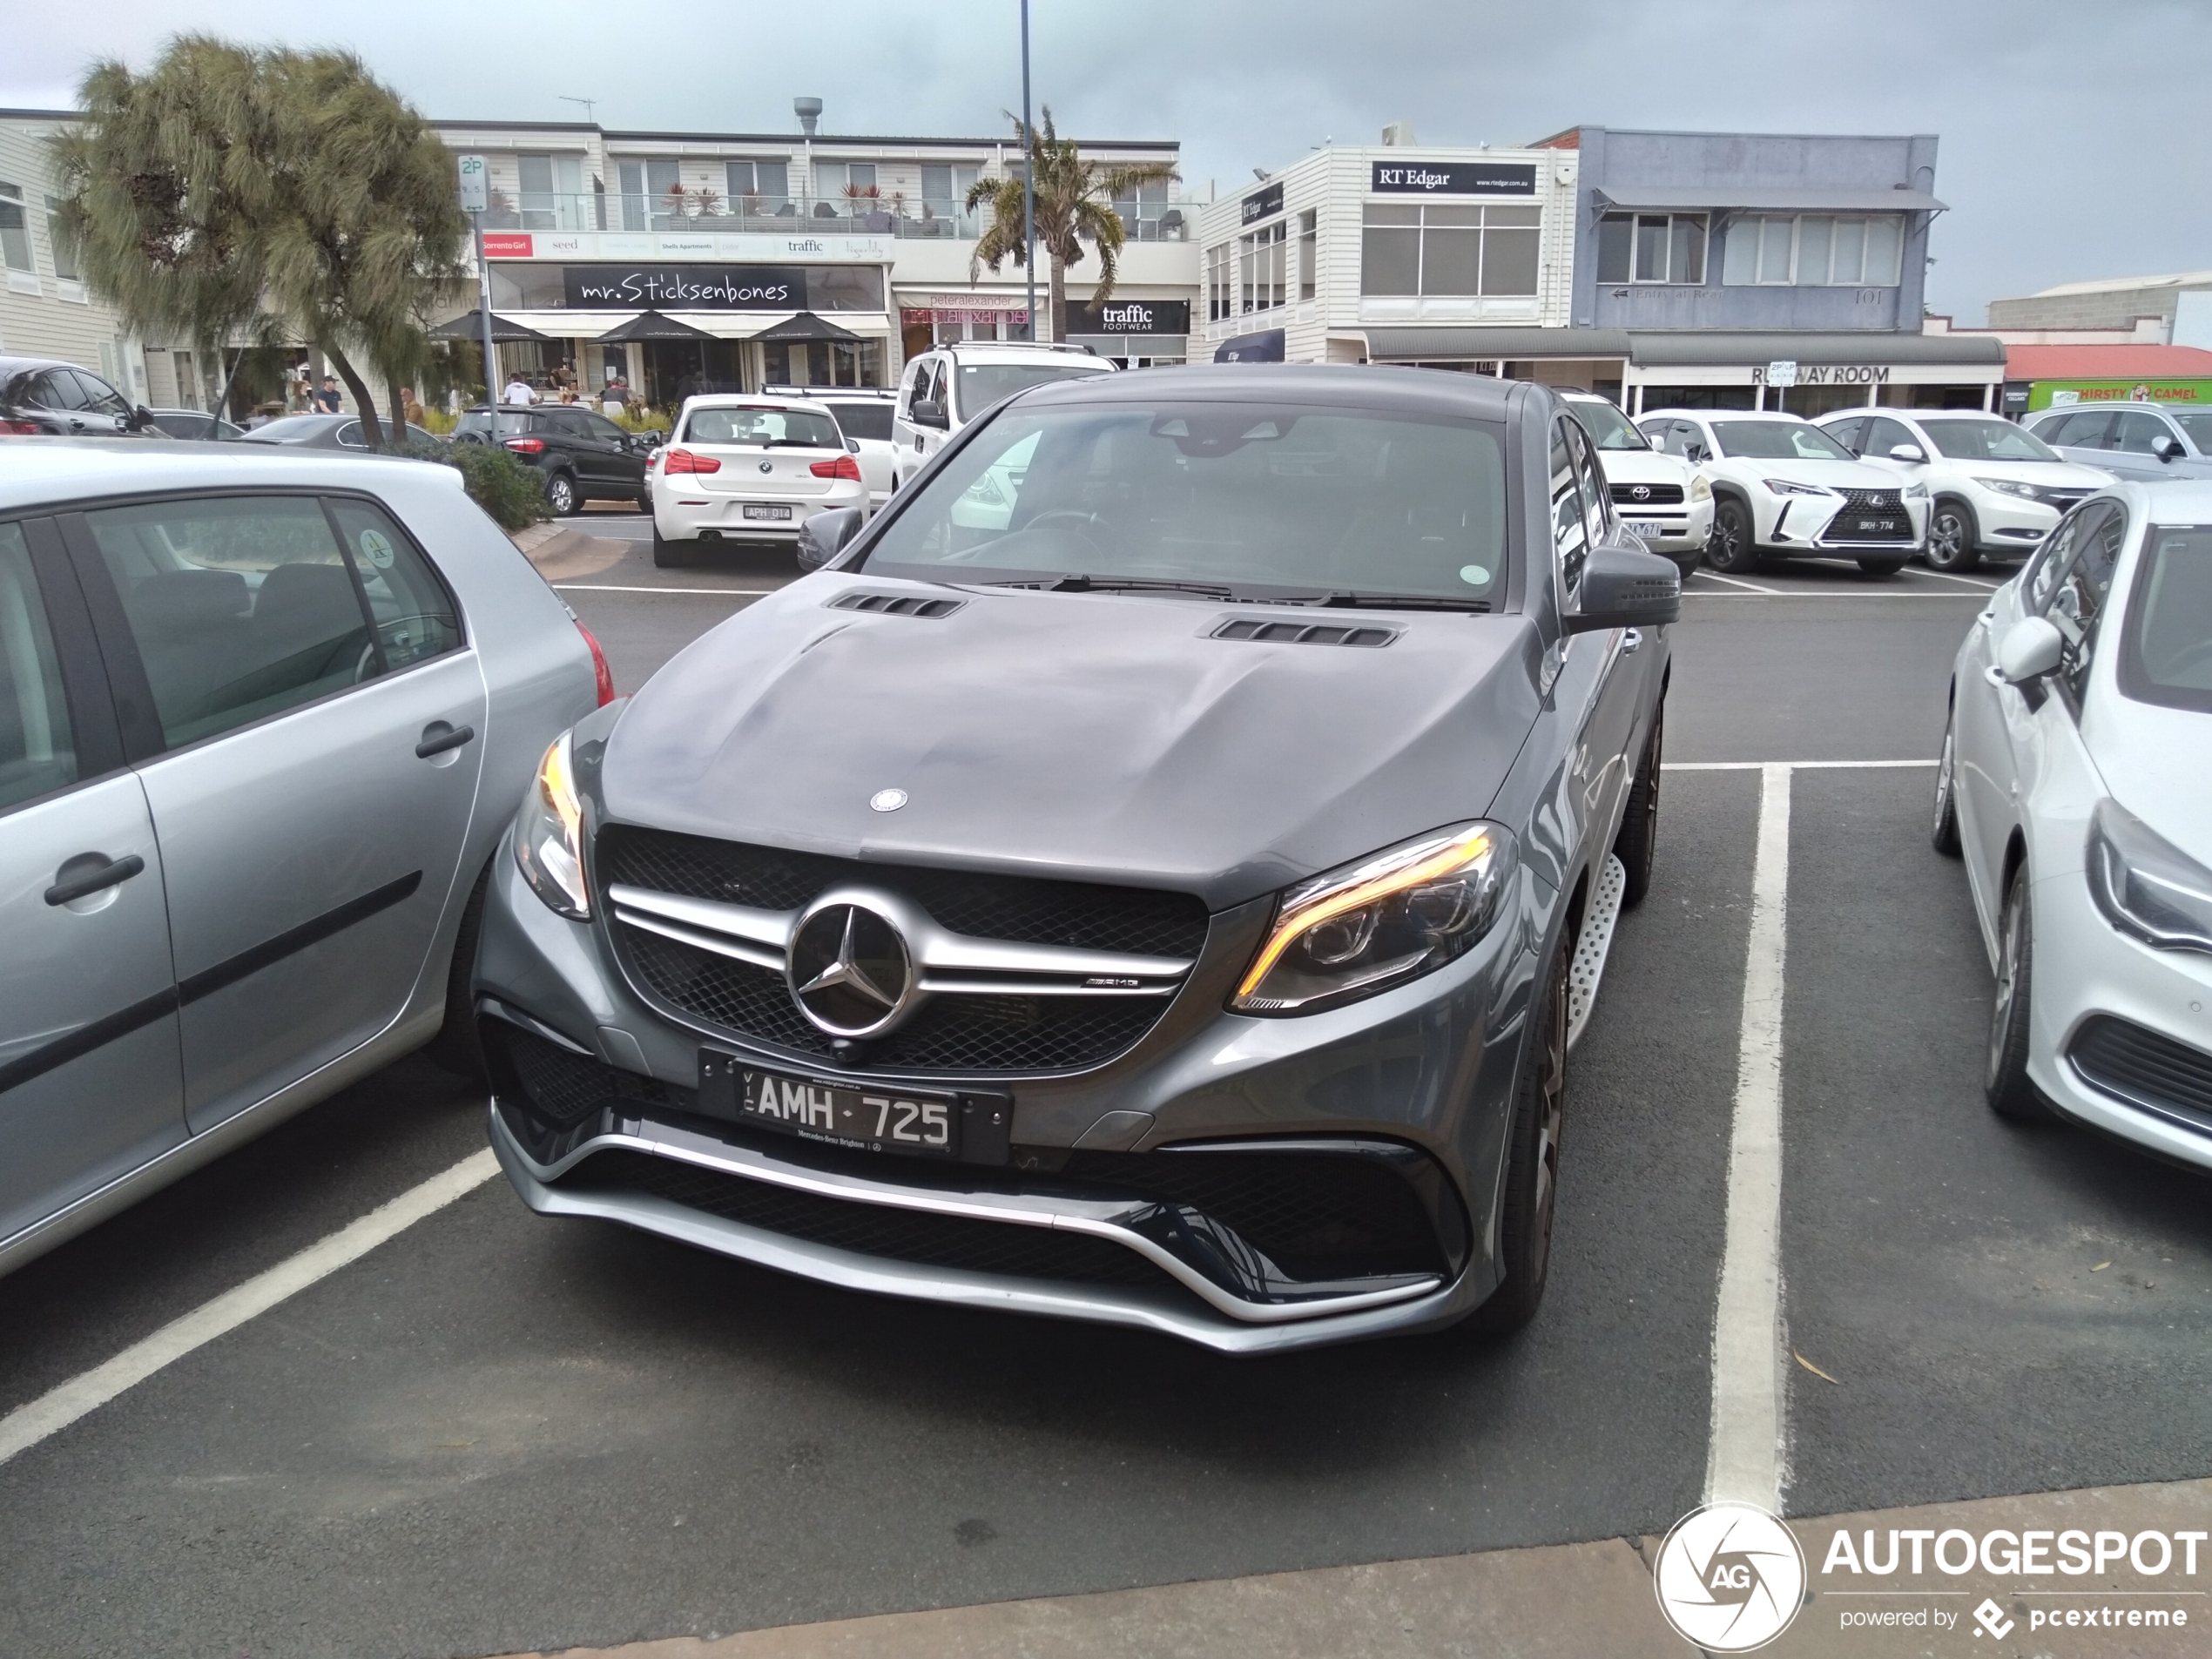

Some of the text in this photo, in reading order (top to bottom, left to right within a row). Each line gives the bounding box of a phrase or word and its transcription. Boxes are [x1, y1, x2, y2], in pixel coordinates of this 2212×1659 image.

[462, 160, 482, 174] 2P
[1379, 169, 1450, 189] RT Edgar
[552, 239, 578, 250] seed
[788, 239, 823, 252] traffic
[930, 294, 1012, 307] peteralexander
[1635, 289, 1723, 300] Entry at Rear
[1855, 290, 1882, 305] 101
[1103, 305, 1152, 323] traffic
[1129, 357, 1138, 366] 2P
[1751, 367, 1890, 384] RWAY ROOM
[2154, 388, 2198, 400] CAMEL
[749, 508, 790, 518] APH 014
[1644, 523, 1660, 535] 671
[1879, 521, 1894, 530] 774
[758, 1076, 948, 1144] AMH 725
[798, 1129, 865, 1150] Mercedes-Benz Brighton
